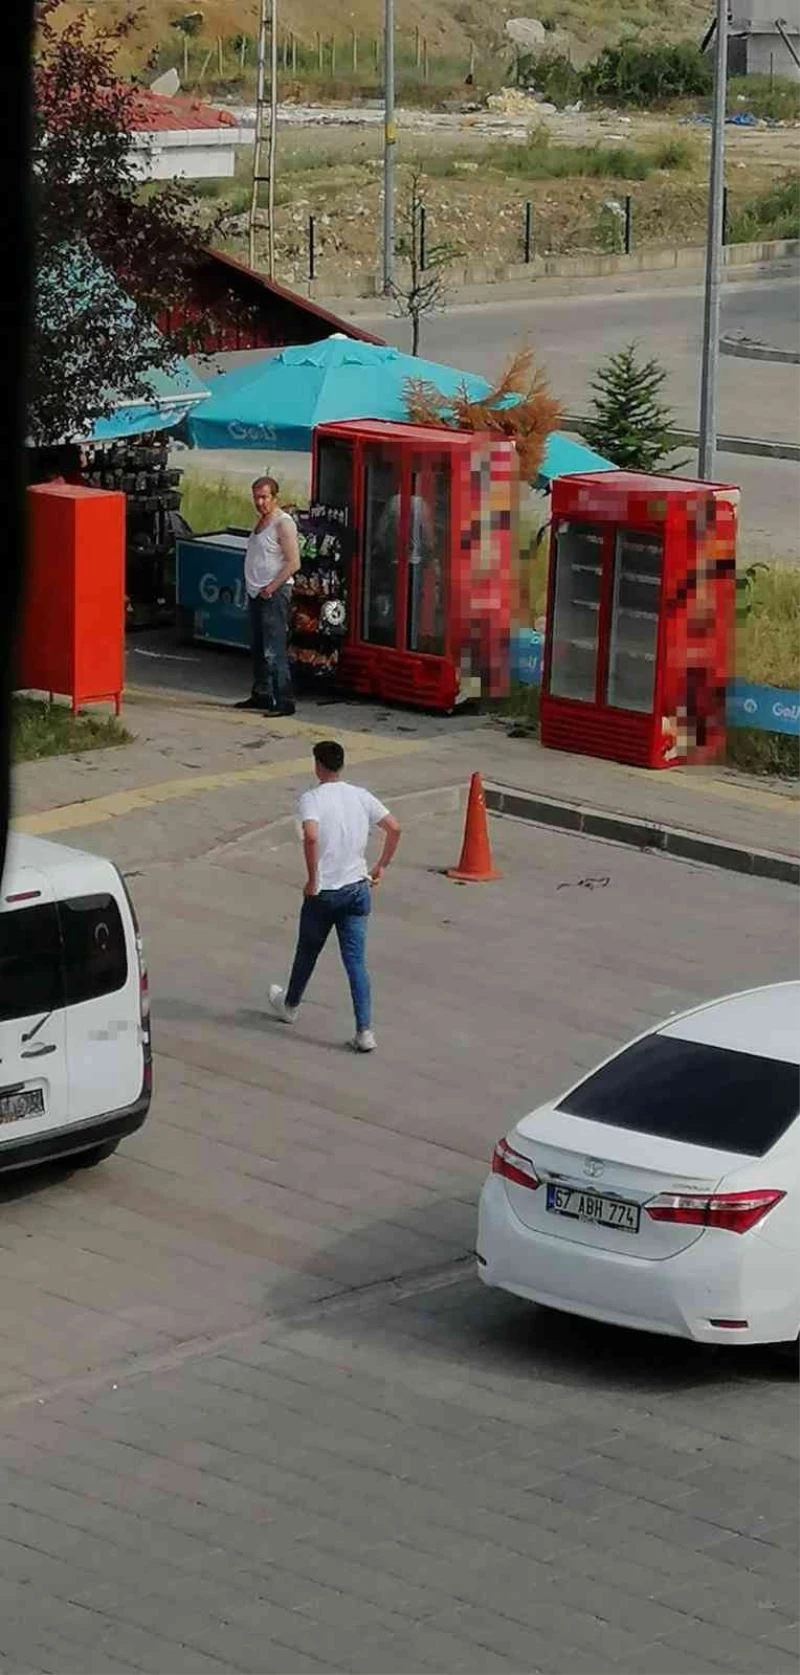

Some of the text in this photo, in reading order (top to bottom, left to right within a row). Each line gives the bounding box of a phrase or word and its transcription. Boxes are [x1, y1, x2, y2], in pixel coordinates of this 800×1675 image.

[555, 1189, 572, 1209] 67
[578, 1195, 603, 1218] ABH
[609, 1203, 635, 1226] 774
